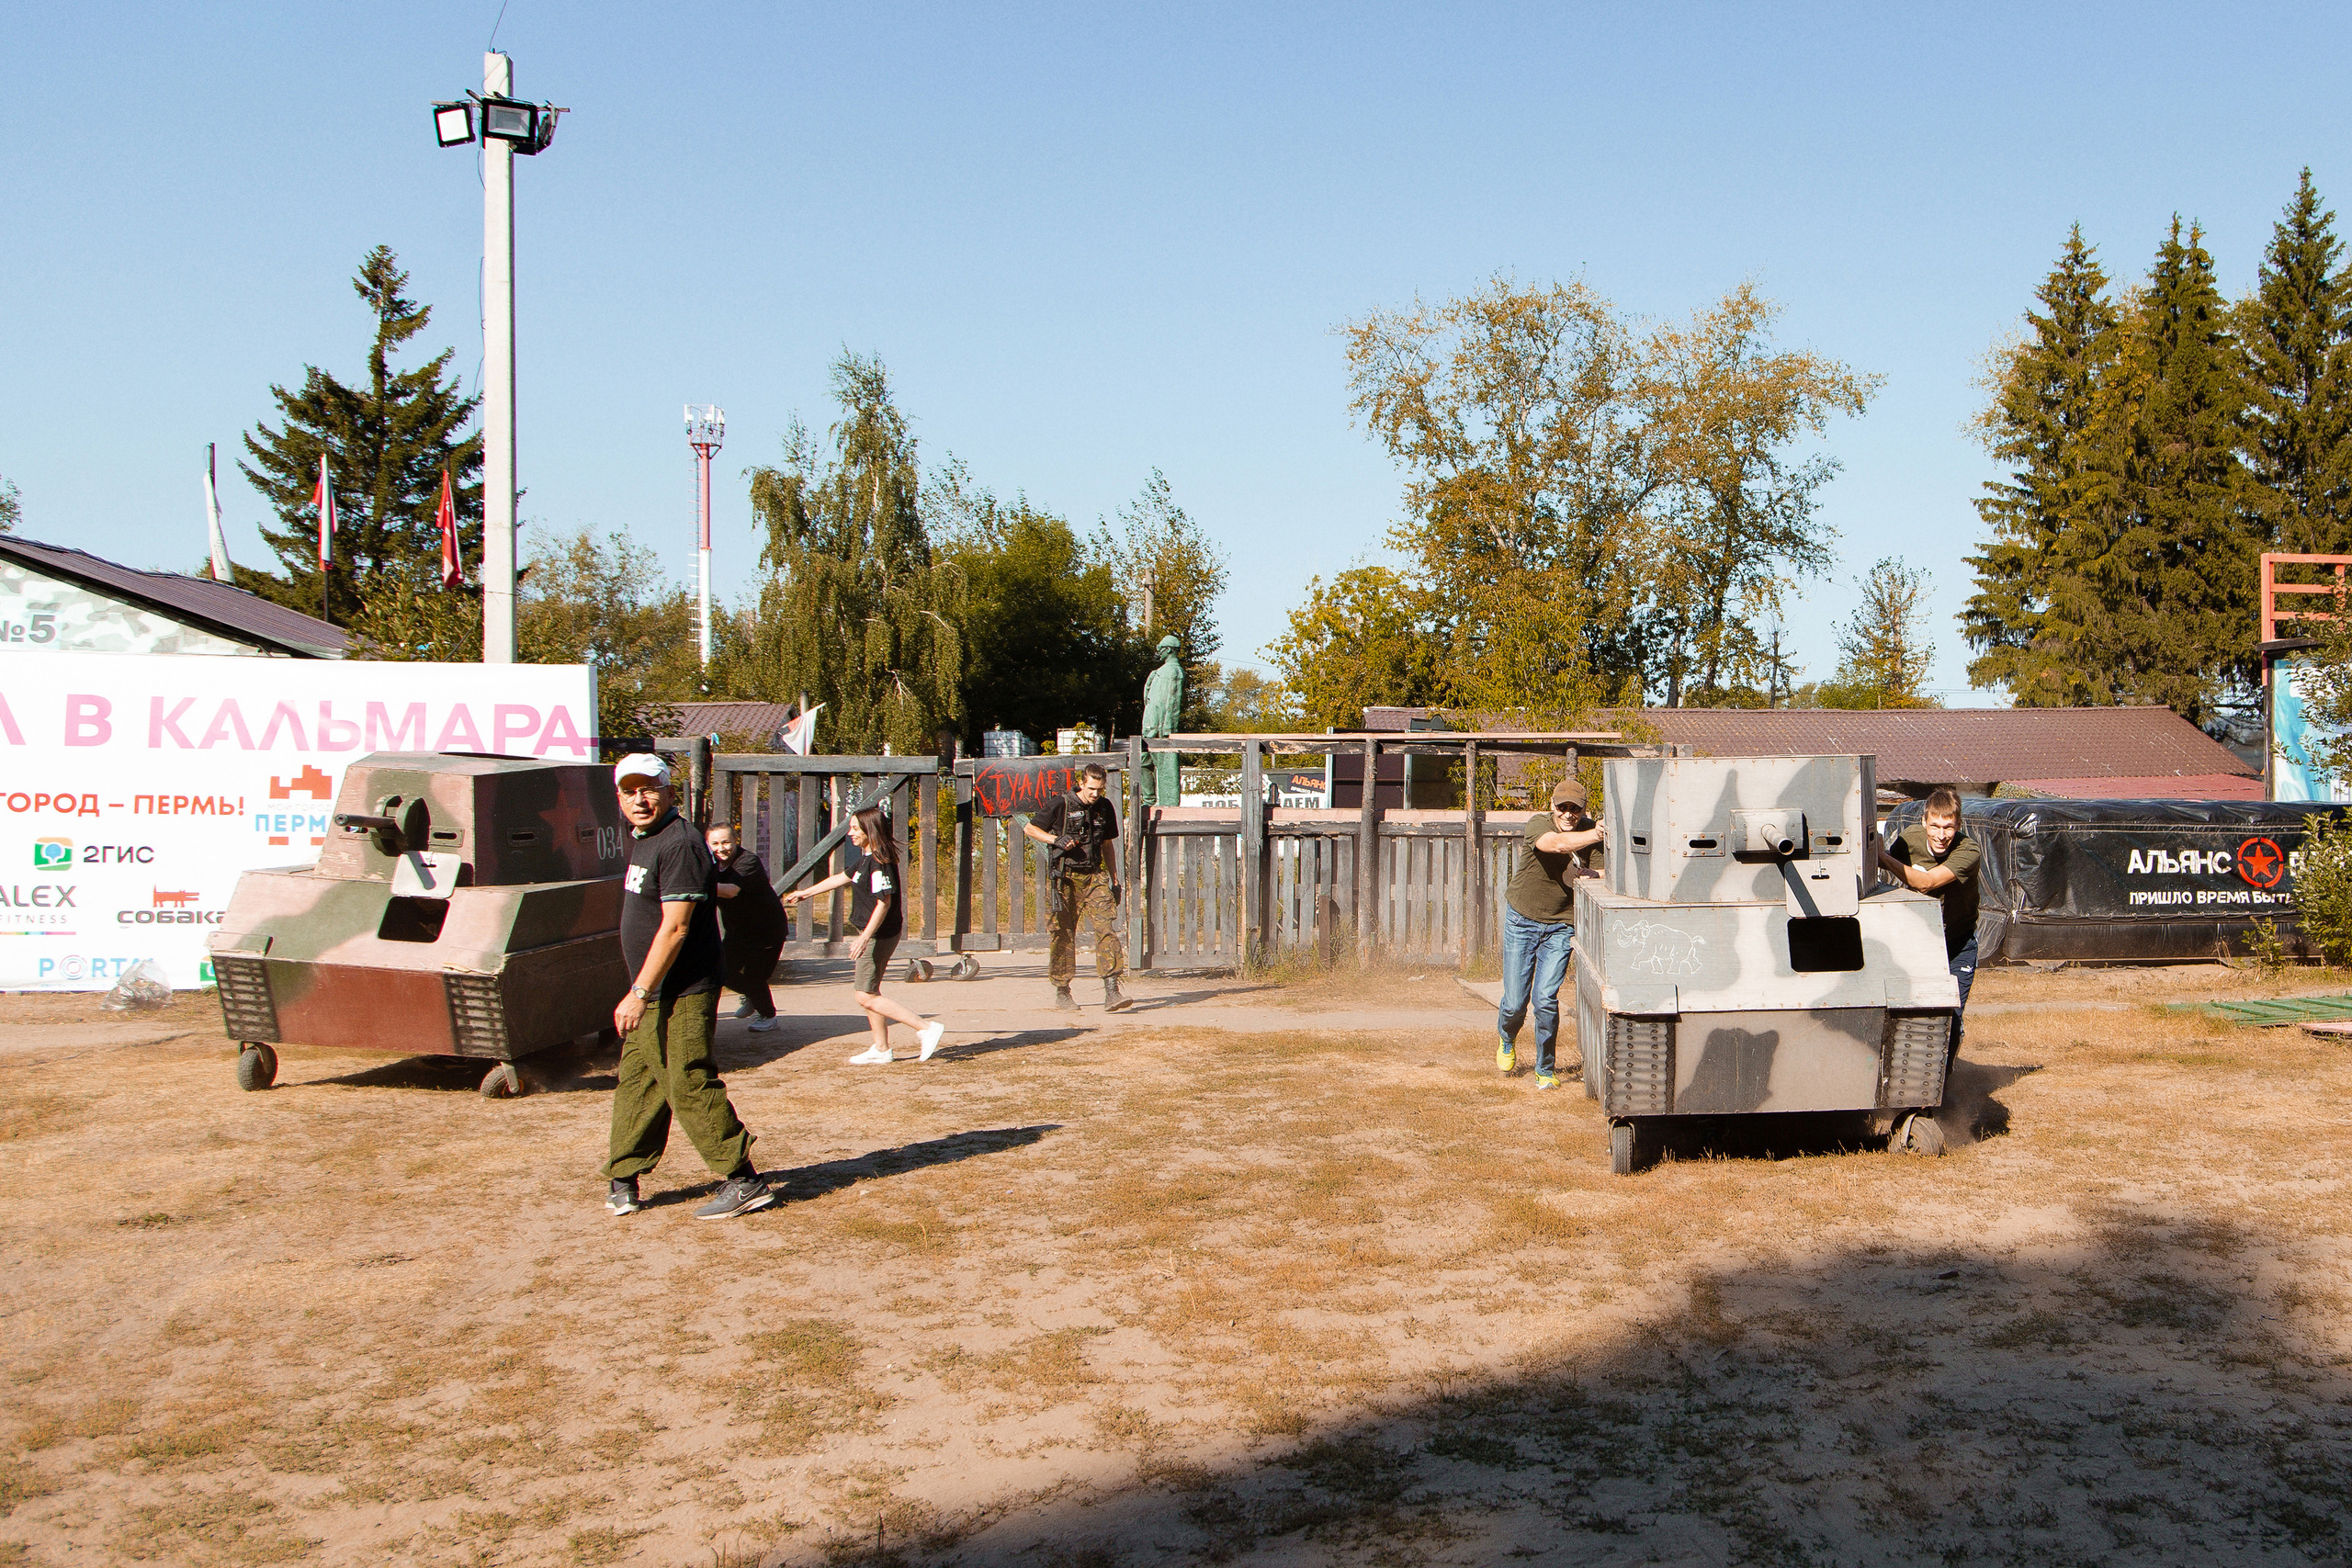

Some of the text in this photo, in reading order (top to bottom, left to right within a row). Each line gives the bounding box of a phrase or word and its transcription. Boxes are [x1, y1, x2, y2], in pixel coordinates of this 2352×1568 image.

[64, 694, 112, 746] В
[148, 695, 589, 756] КАЛЬМАРА
[133, 795, 244, 816] ПЕРМЬ!
[255, 814, 327, 832] ПЕРМ
[596, 825, 624, 860] 034
[83, 845, 155, 863] 2ГИС
[2127, 850, 2233, 874] АЛЬЯНС
[2129, 891, 2193, 905] ПРИШЛО
[2197, 891, 2251, 905] ВРЕМЯ
[0, 914, 67, 924] ITNESS
[39, 954, 154, 980] PORT
